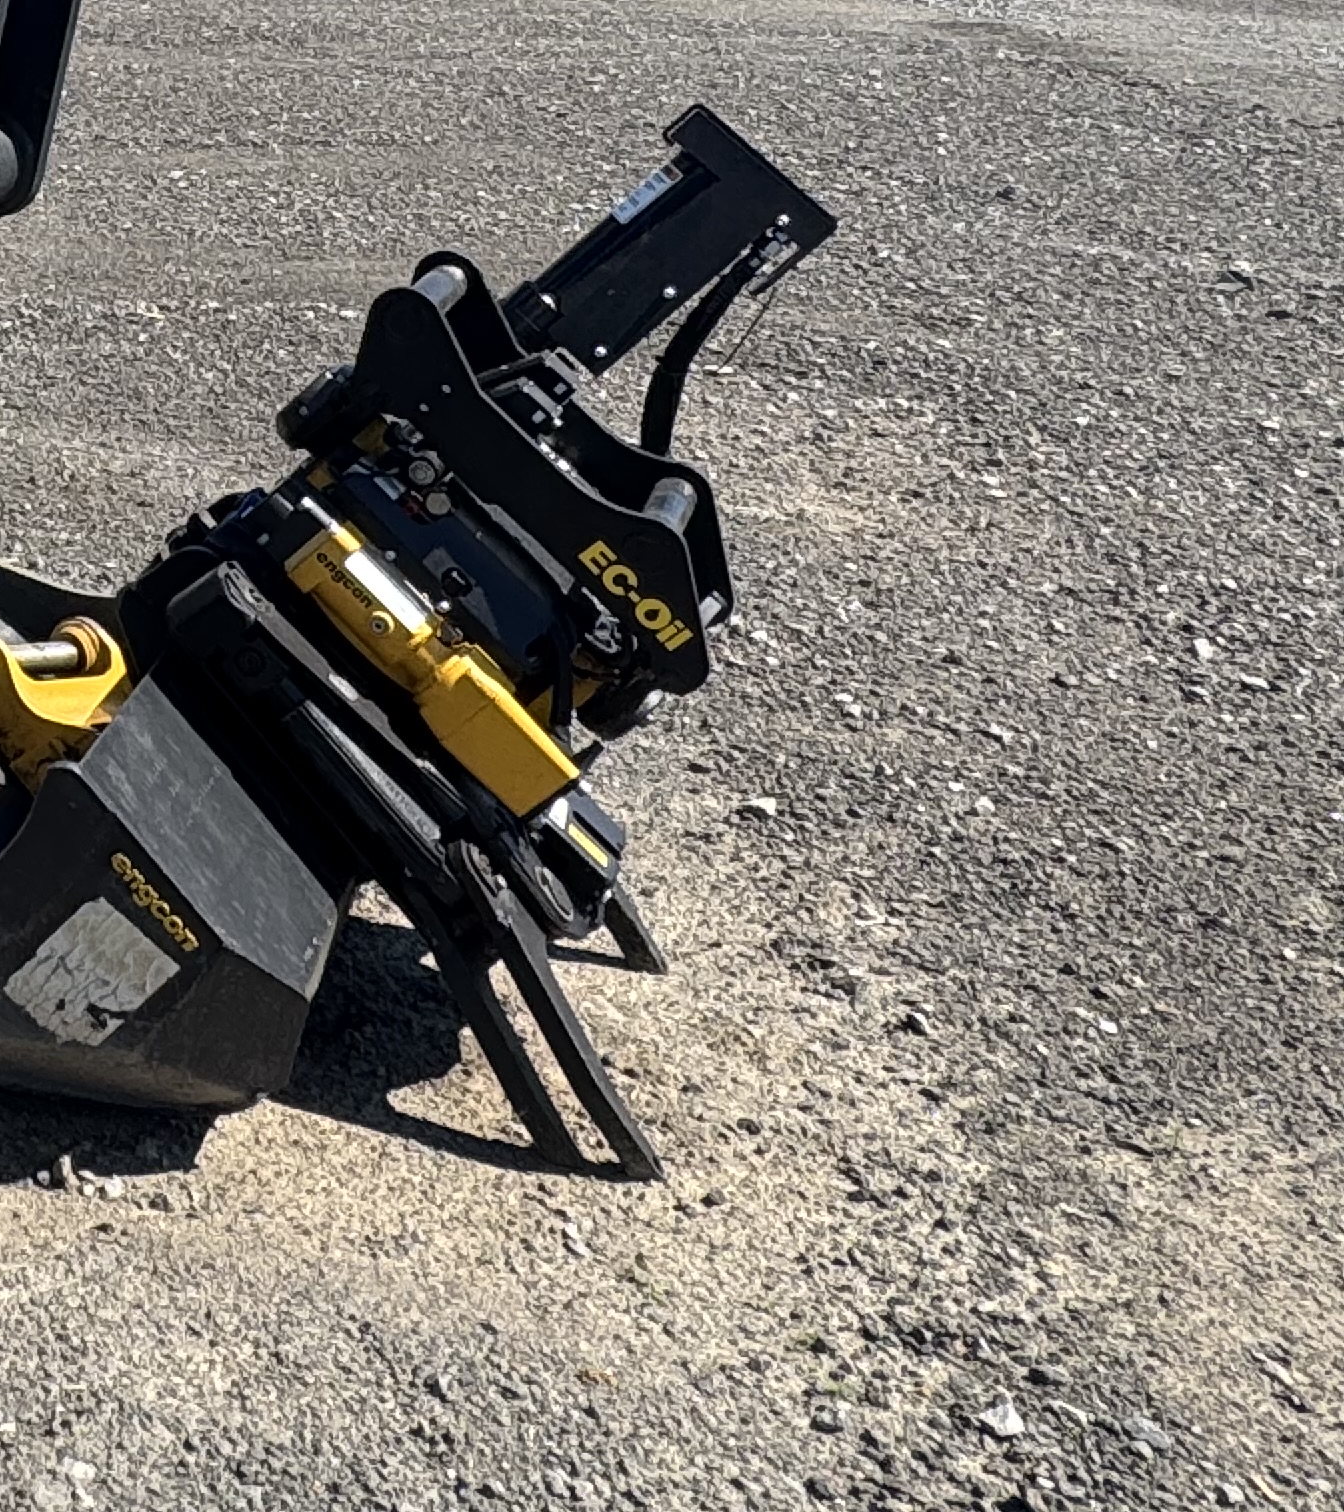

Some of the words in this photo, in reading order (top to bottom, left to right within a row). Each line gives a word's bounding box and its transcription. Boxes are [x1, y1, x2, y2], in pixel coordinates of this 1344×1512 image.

[316, 552, 372, 609] engcon
[578, 540, 694, 652] EC-Oil
[111, 852, 200, 952] engcon
